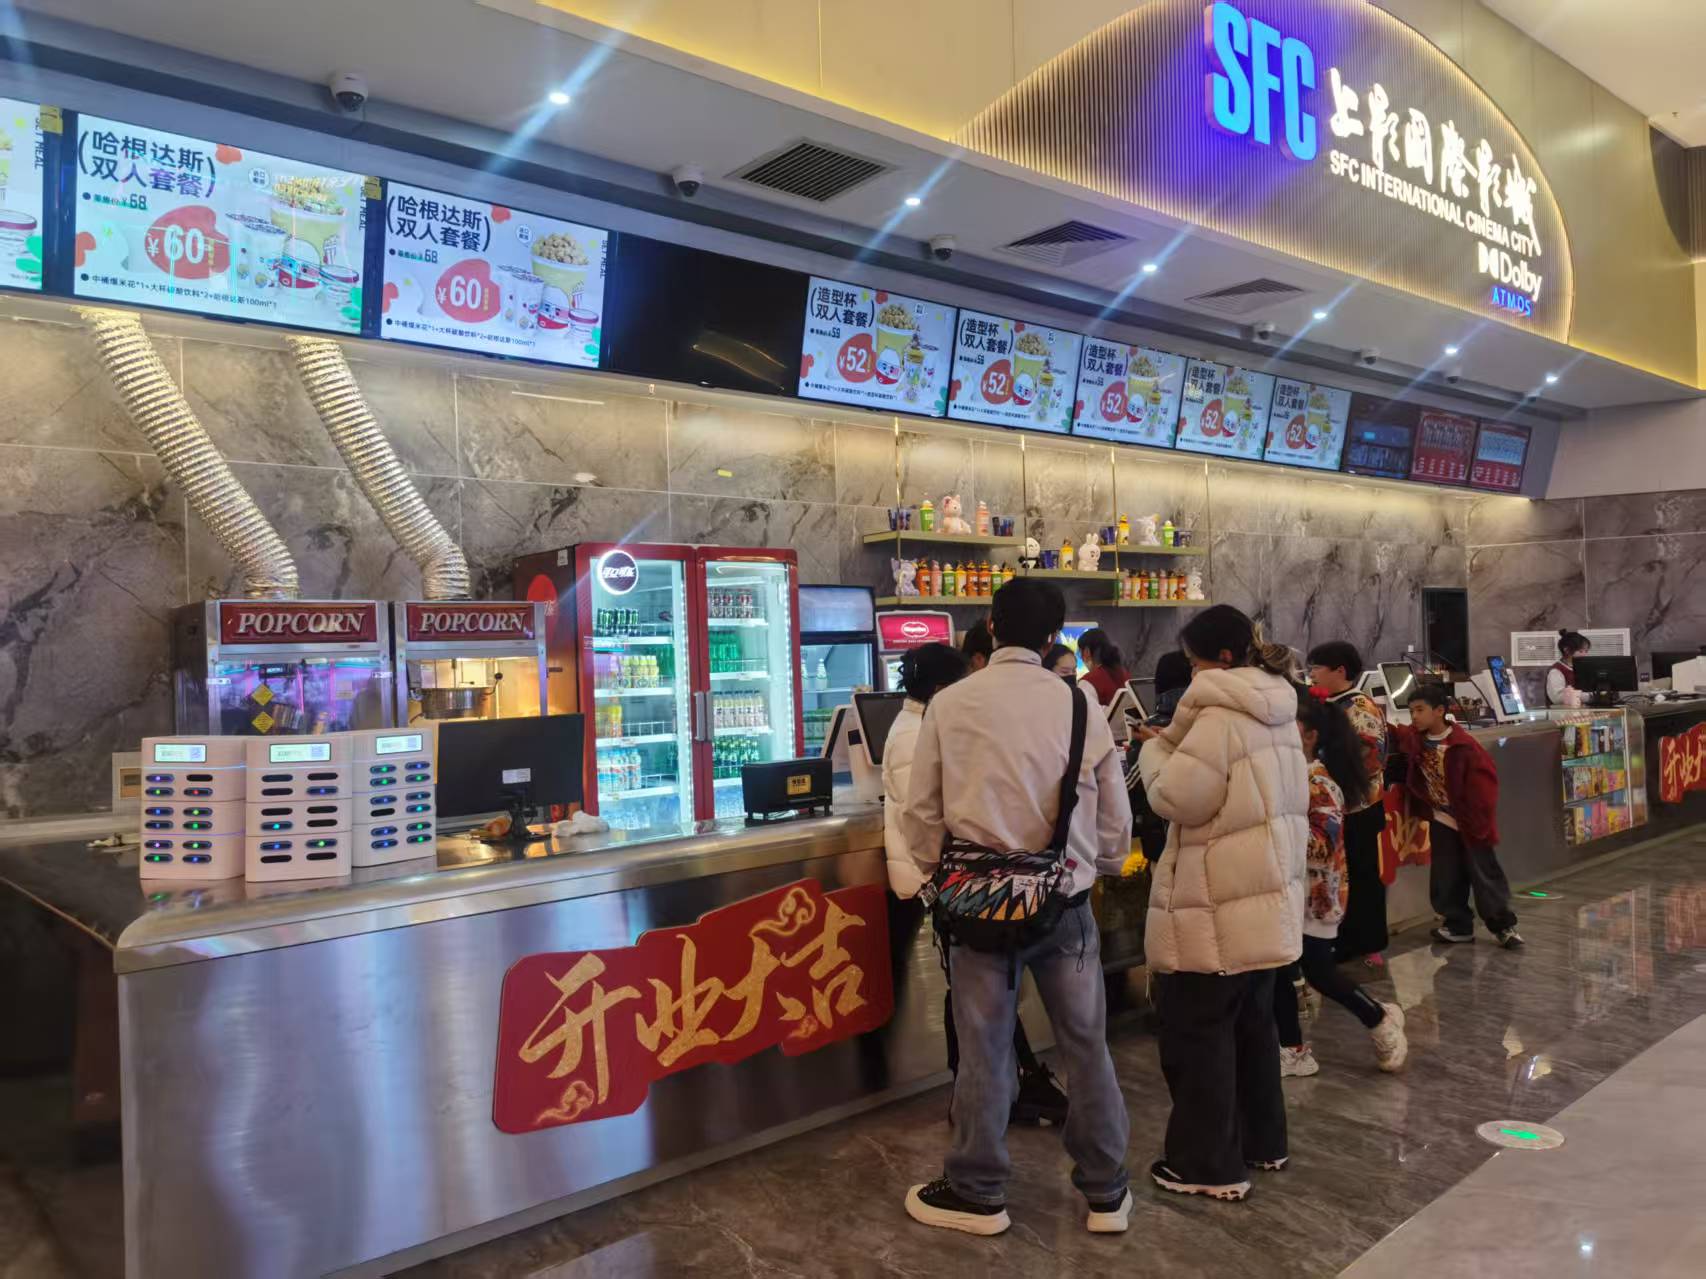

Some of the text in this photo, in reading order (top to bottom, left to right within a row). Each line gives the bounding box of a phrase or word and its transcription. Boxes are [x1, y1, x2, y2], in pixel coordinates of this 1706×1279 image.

[1207, 2, 1318, 161] SFC
[92, 130, 204, 172] 哈根达斯
[90, 155, 203, 199] 双人套餐
[397, 195, 483, 232] 哈根达斯
[1330, 150, 1537, 257] SFC INTERNATIONAL CINEMA CITY
[148, 224, 206, 265] ¥60
[395, 216, 481, 253] 双人套餐
[1500, 251, 1542, 302] Dolby
[436, 275, 483, 310] ¥60
[817, 286, 857, 309] 造型杯
[1491, 287, 1532, 318] ATMOS
[815, 303, 868, 328] 双人套餐
[966, 318, 999, 337] 造型杯
[964, 333, 1009, 355] 双人套餐
[1088, 343, 1117, 361] 造型杯
[839, 347, 868, 373] ¥52
[1087, 358, 1124, 377] 双人套餐
[983, 371, 1006, 396] ¥52
[1101, 391, 1122, 415] ¥52
[237, 612, 368, 635] POPCORN
[419, 611, 526, 634] POPCORN
[518, 897, 867, 1105] 开业大吉
